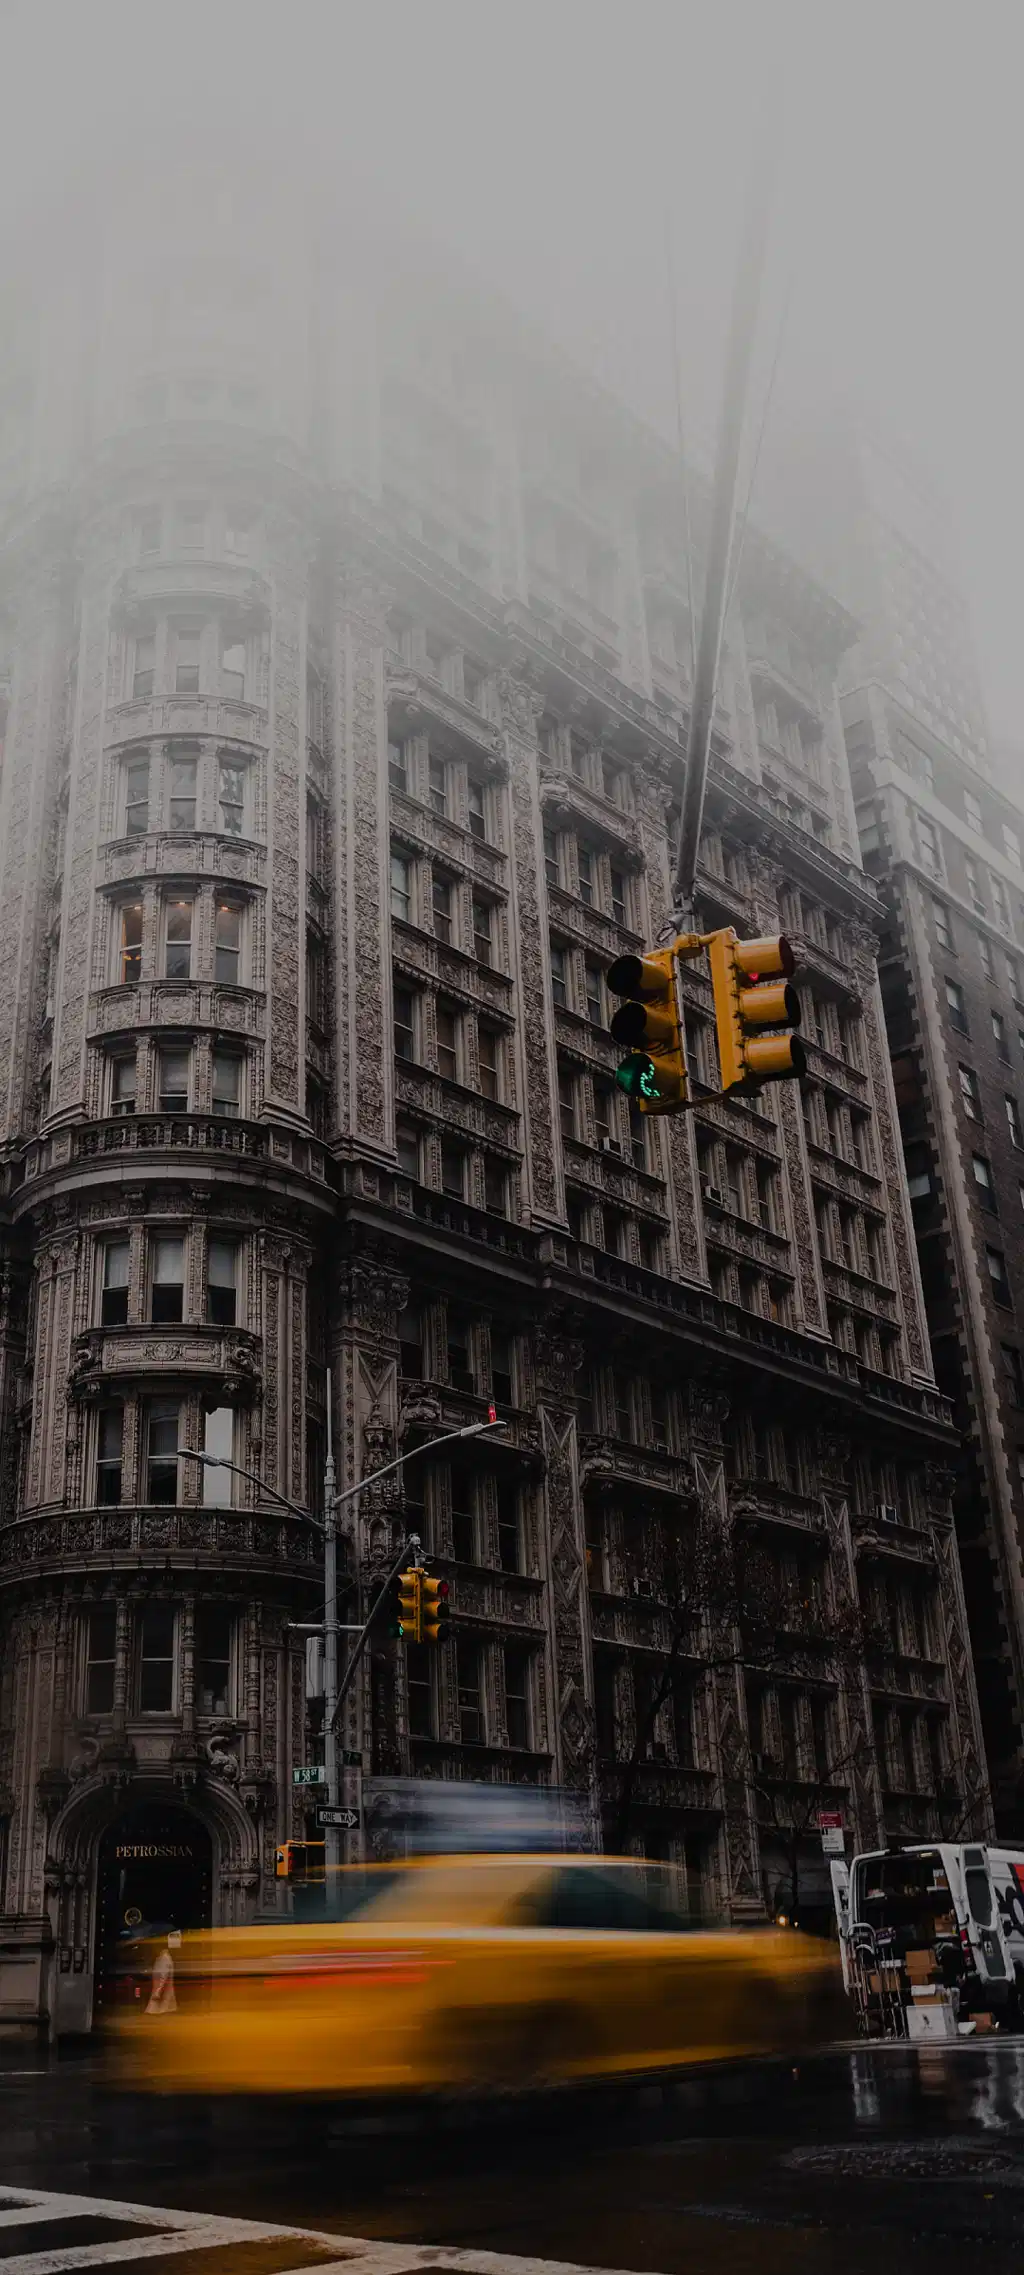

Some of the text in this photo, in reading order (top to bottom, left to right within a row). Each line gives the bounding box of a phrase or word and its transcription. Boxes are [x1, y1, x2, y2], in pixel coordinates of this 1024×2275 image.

[302, 1769, 311, 1782] 58
[322, 1811, 354, 1824] ONE WAY
[115, 1845, 193, 1858] PETROSSIAN
